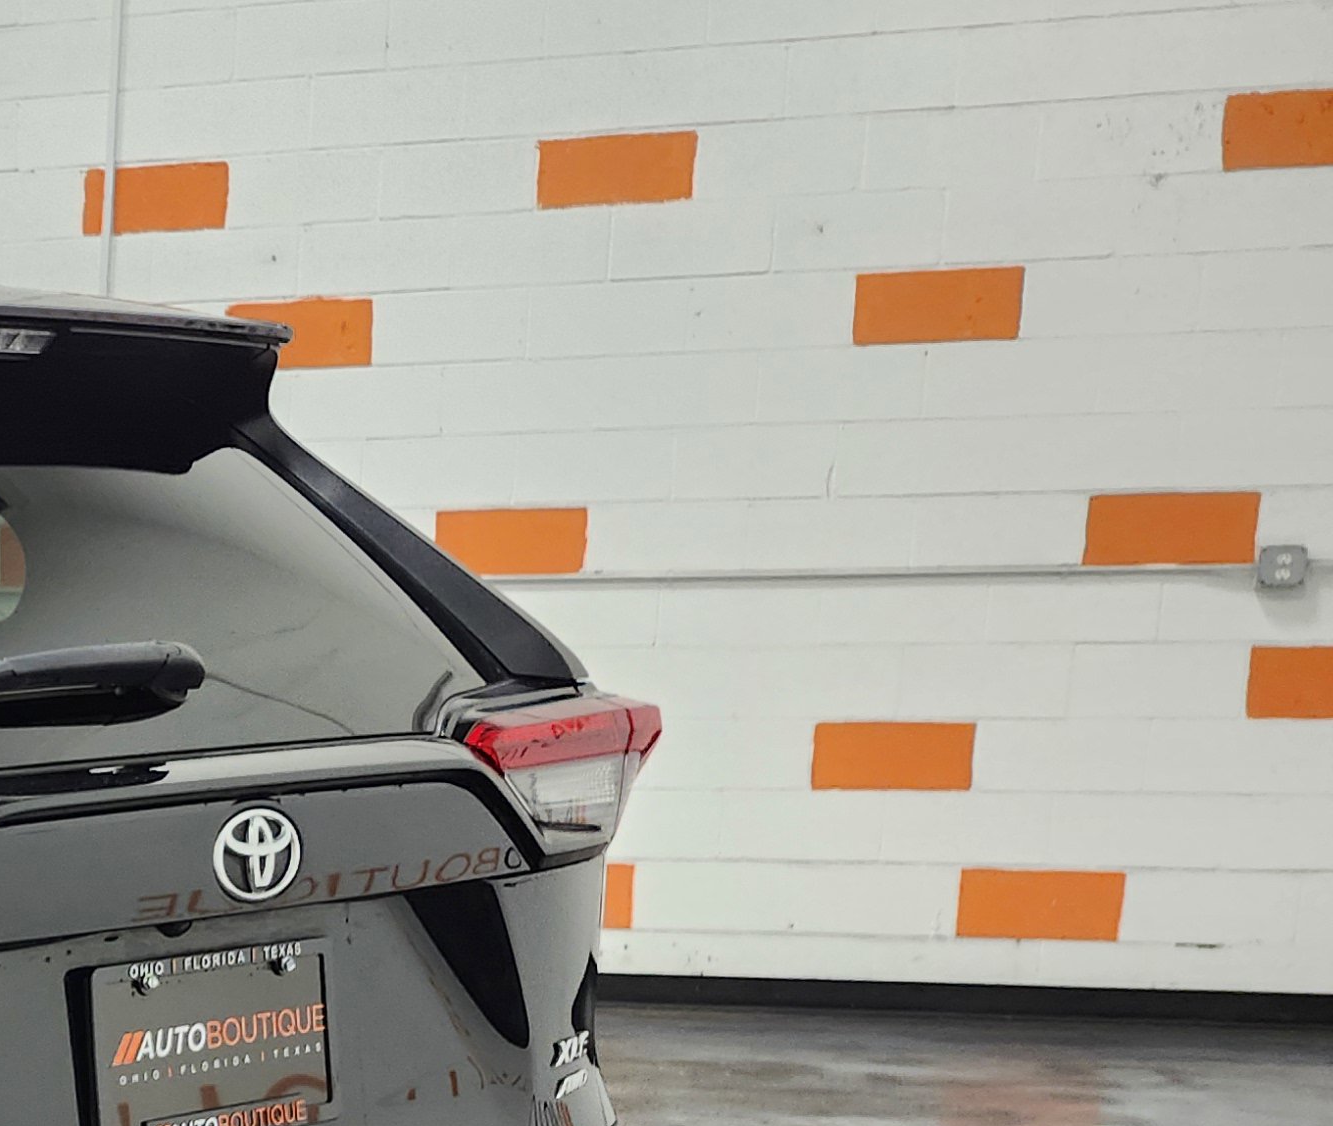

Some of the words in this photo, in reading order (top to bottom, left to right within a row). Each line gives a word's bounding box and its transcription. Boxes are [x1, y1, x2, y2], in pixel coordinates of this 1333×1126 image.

[129, 961, 164, 979] OHIO
[184, 951, 246, 971] FLORIDA
[263, 942, 301, 961] TEXAS
[136, 1003, 326, 1062] AUTOBOUTIQUE
[119, 1069, 160, 1086] OHIO
[180, 1053, 251, 1075] FLORIDA
[273, 1042, 322, 1060] TEXAS
